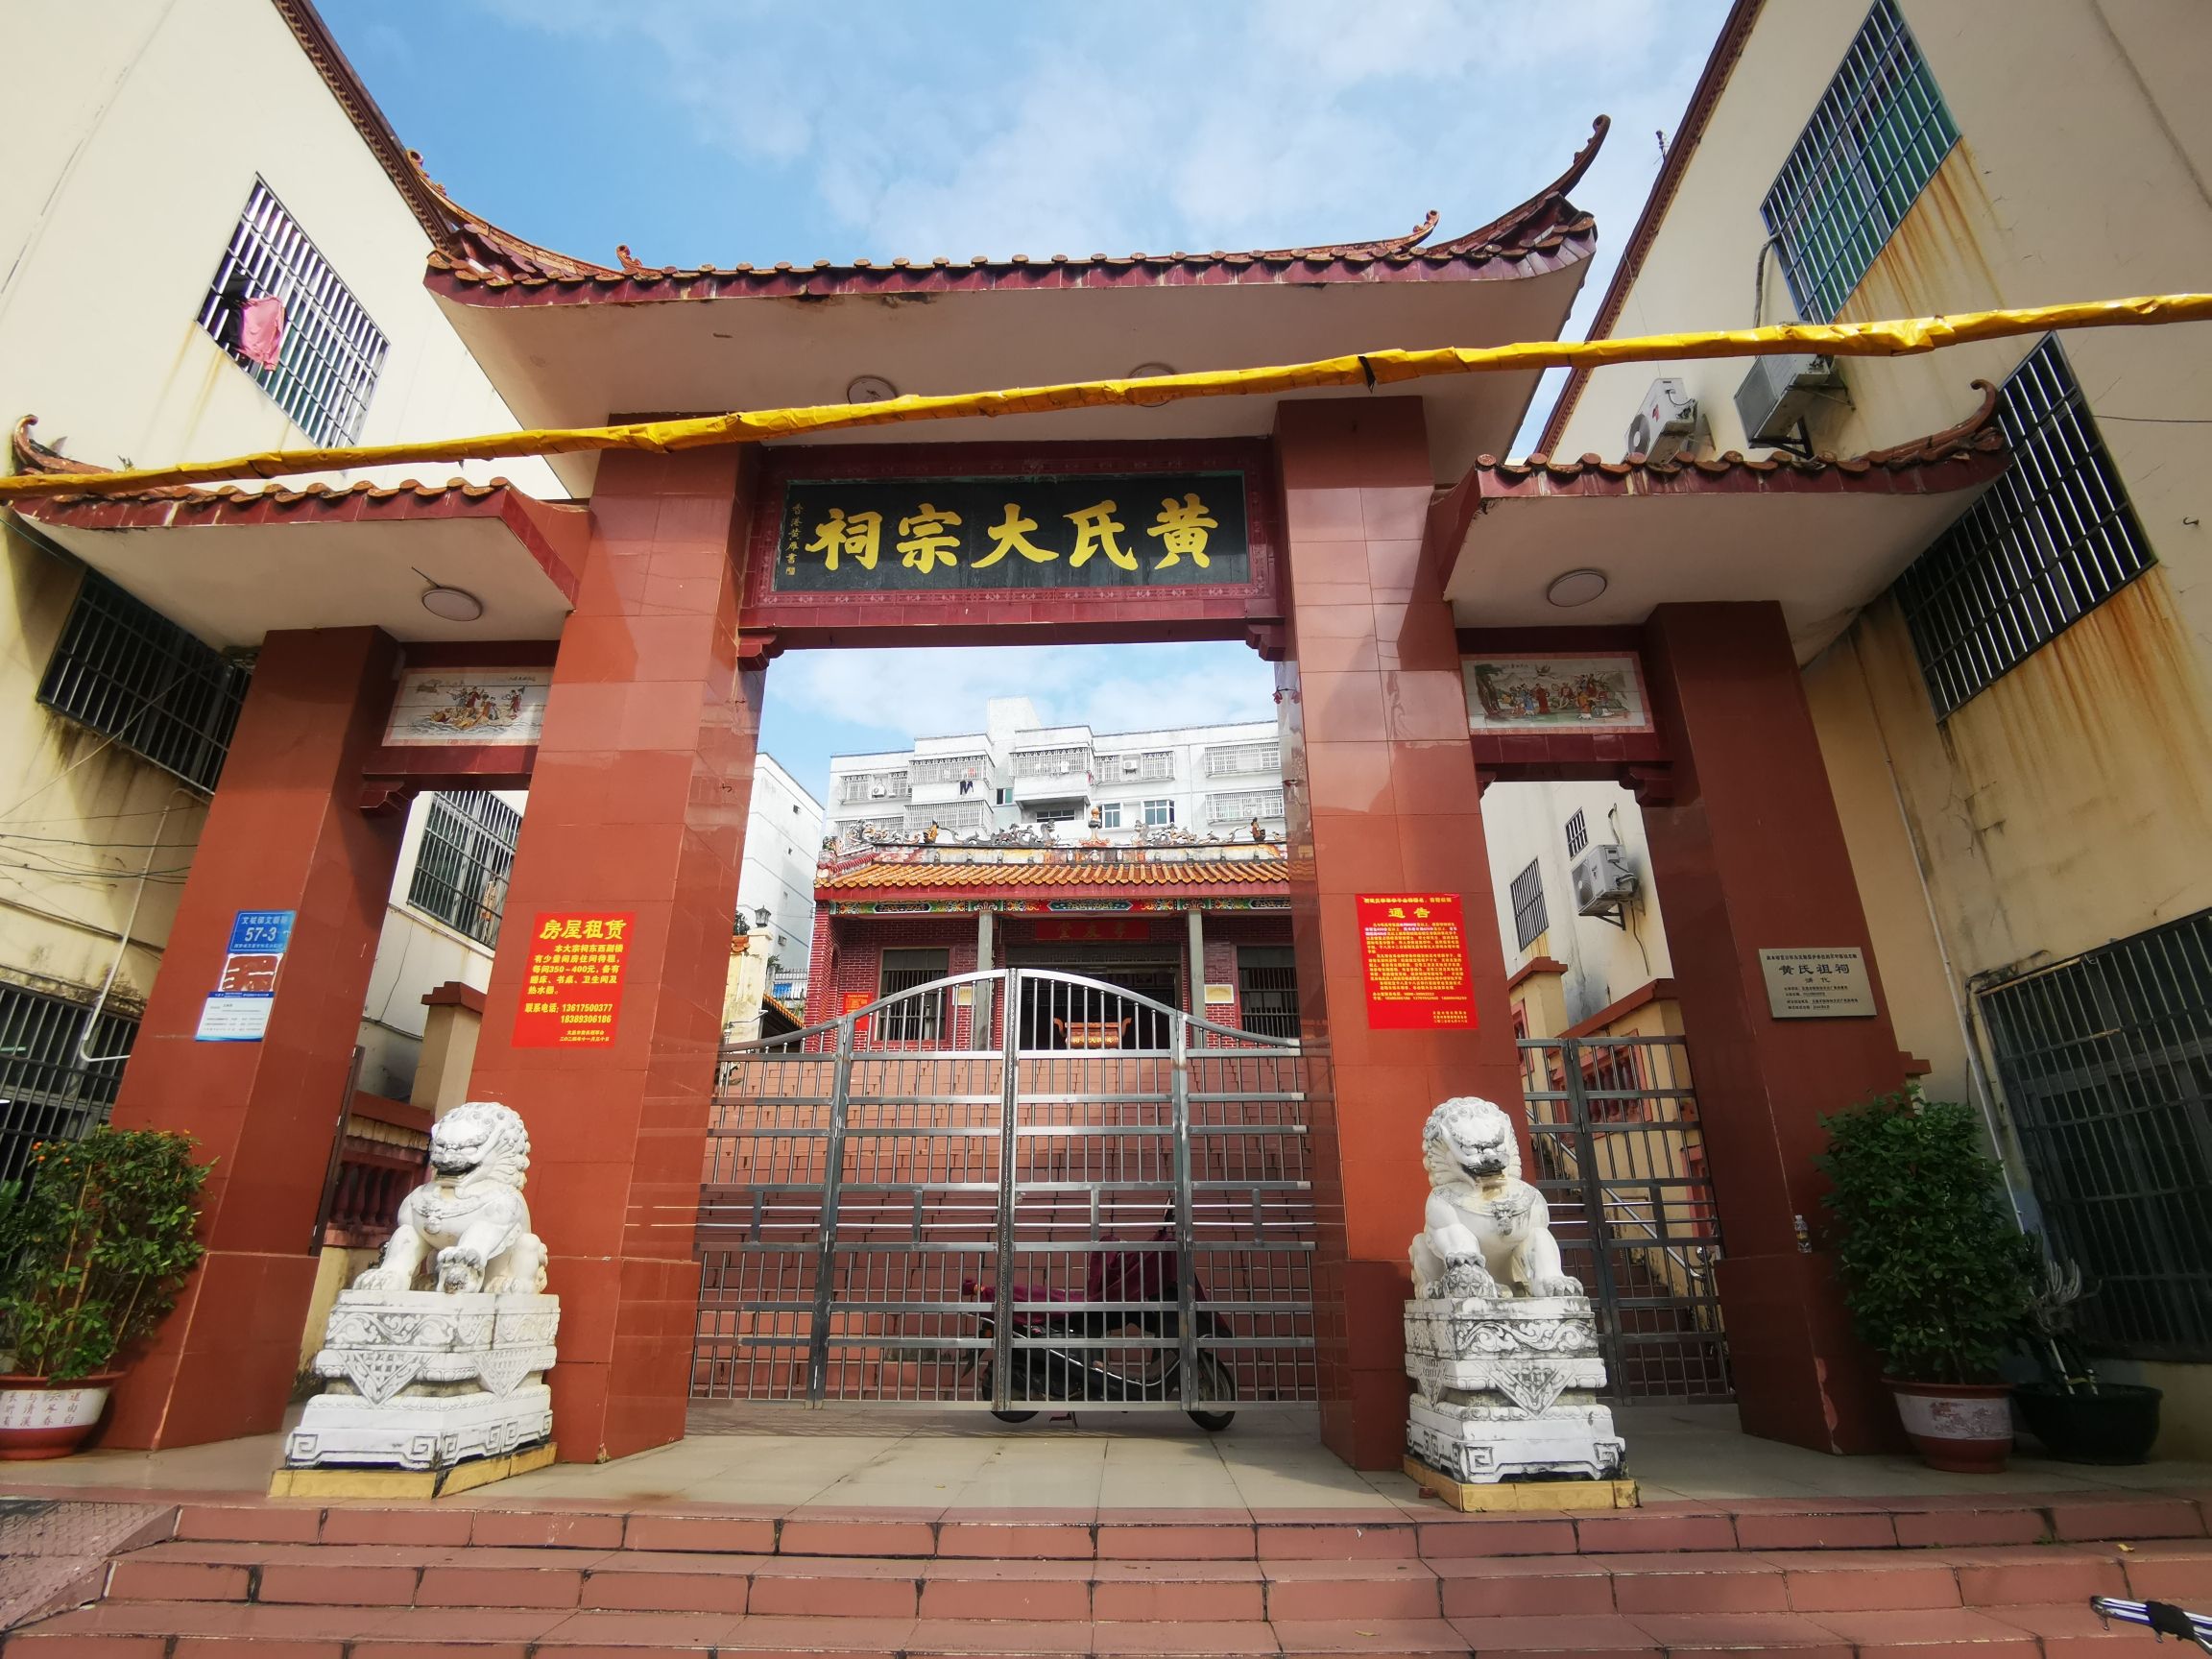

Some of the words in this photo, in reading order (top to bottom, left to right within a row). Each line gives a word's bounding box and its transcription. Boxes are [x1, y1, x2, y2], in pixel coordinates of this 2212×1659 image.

[805, 493, 1219, 574] 黄氏大宗祠
[539, 919, 627, 940] 房屋租赁
[1778, 964, 1850, 975] 黄氏祖祠
